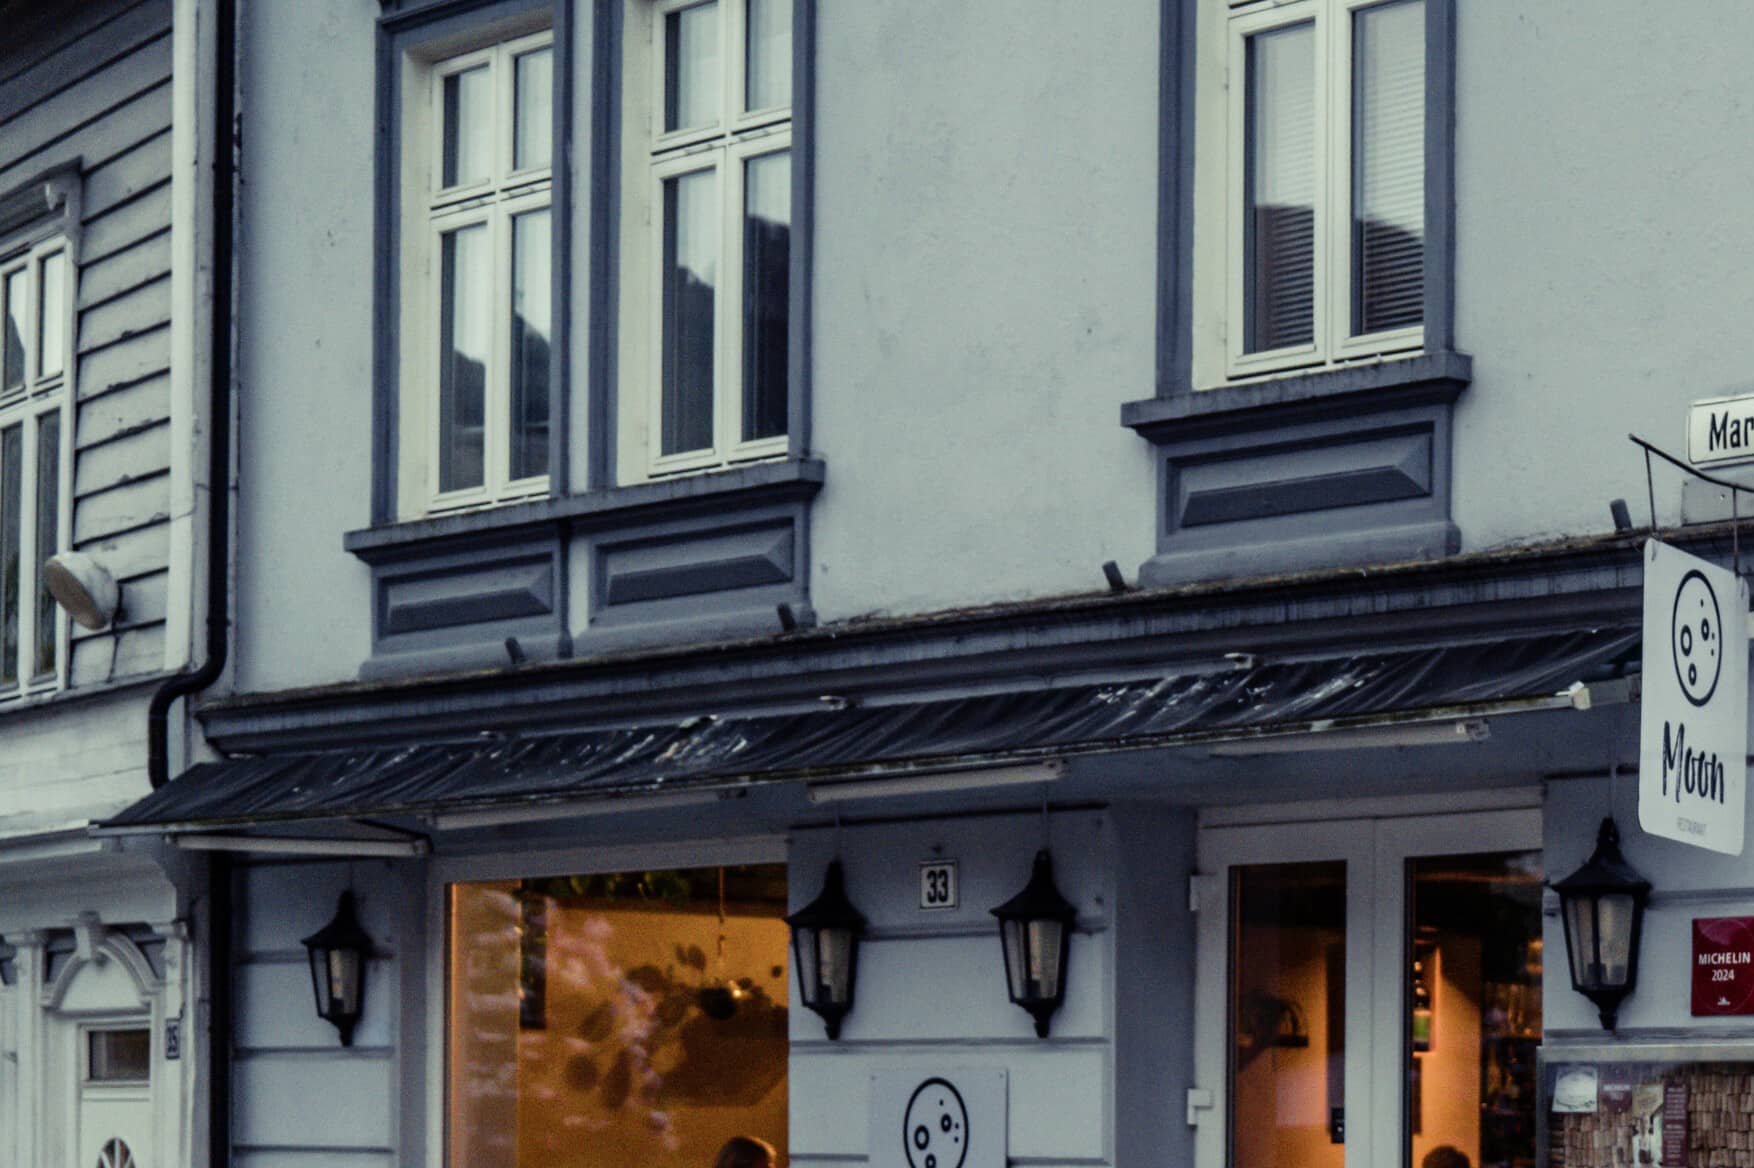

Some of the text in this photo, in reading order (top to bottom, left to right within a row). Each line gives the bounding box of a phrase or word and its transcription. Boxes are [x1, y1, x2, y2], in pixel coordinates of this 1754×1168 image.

[1662, 720, 1724, 804] Moon
[927, 870, 948, 903] 33
[1698, 951, 1751, 965] MICHELIN
[1711, 969, 1735, 982] 2024
